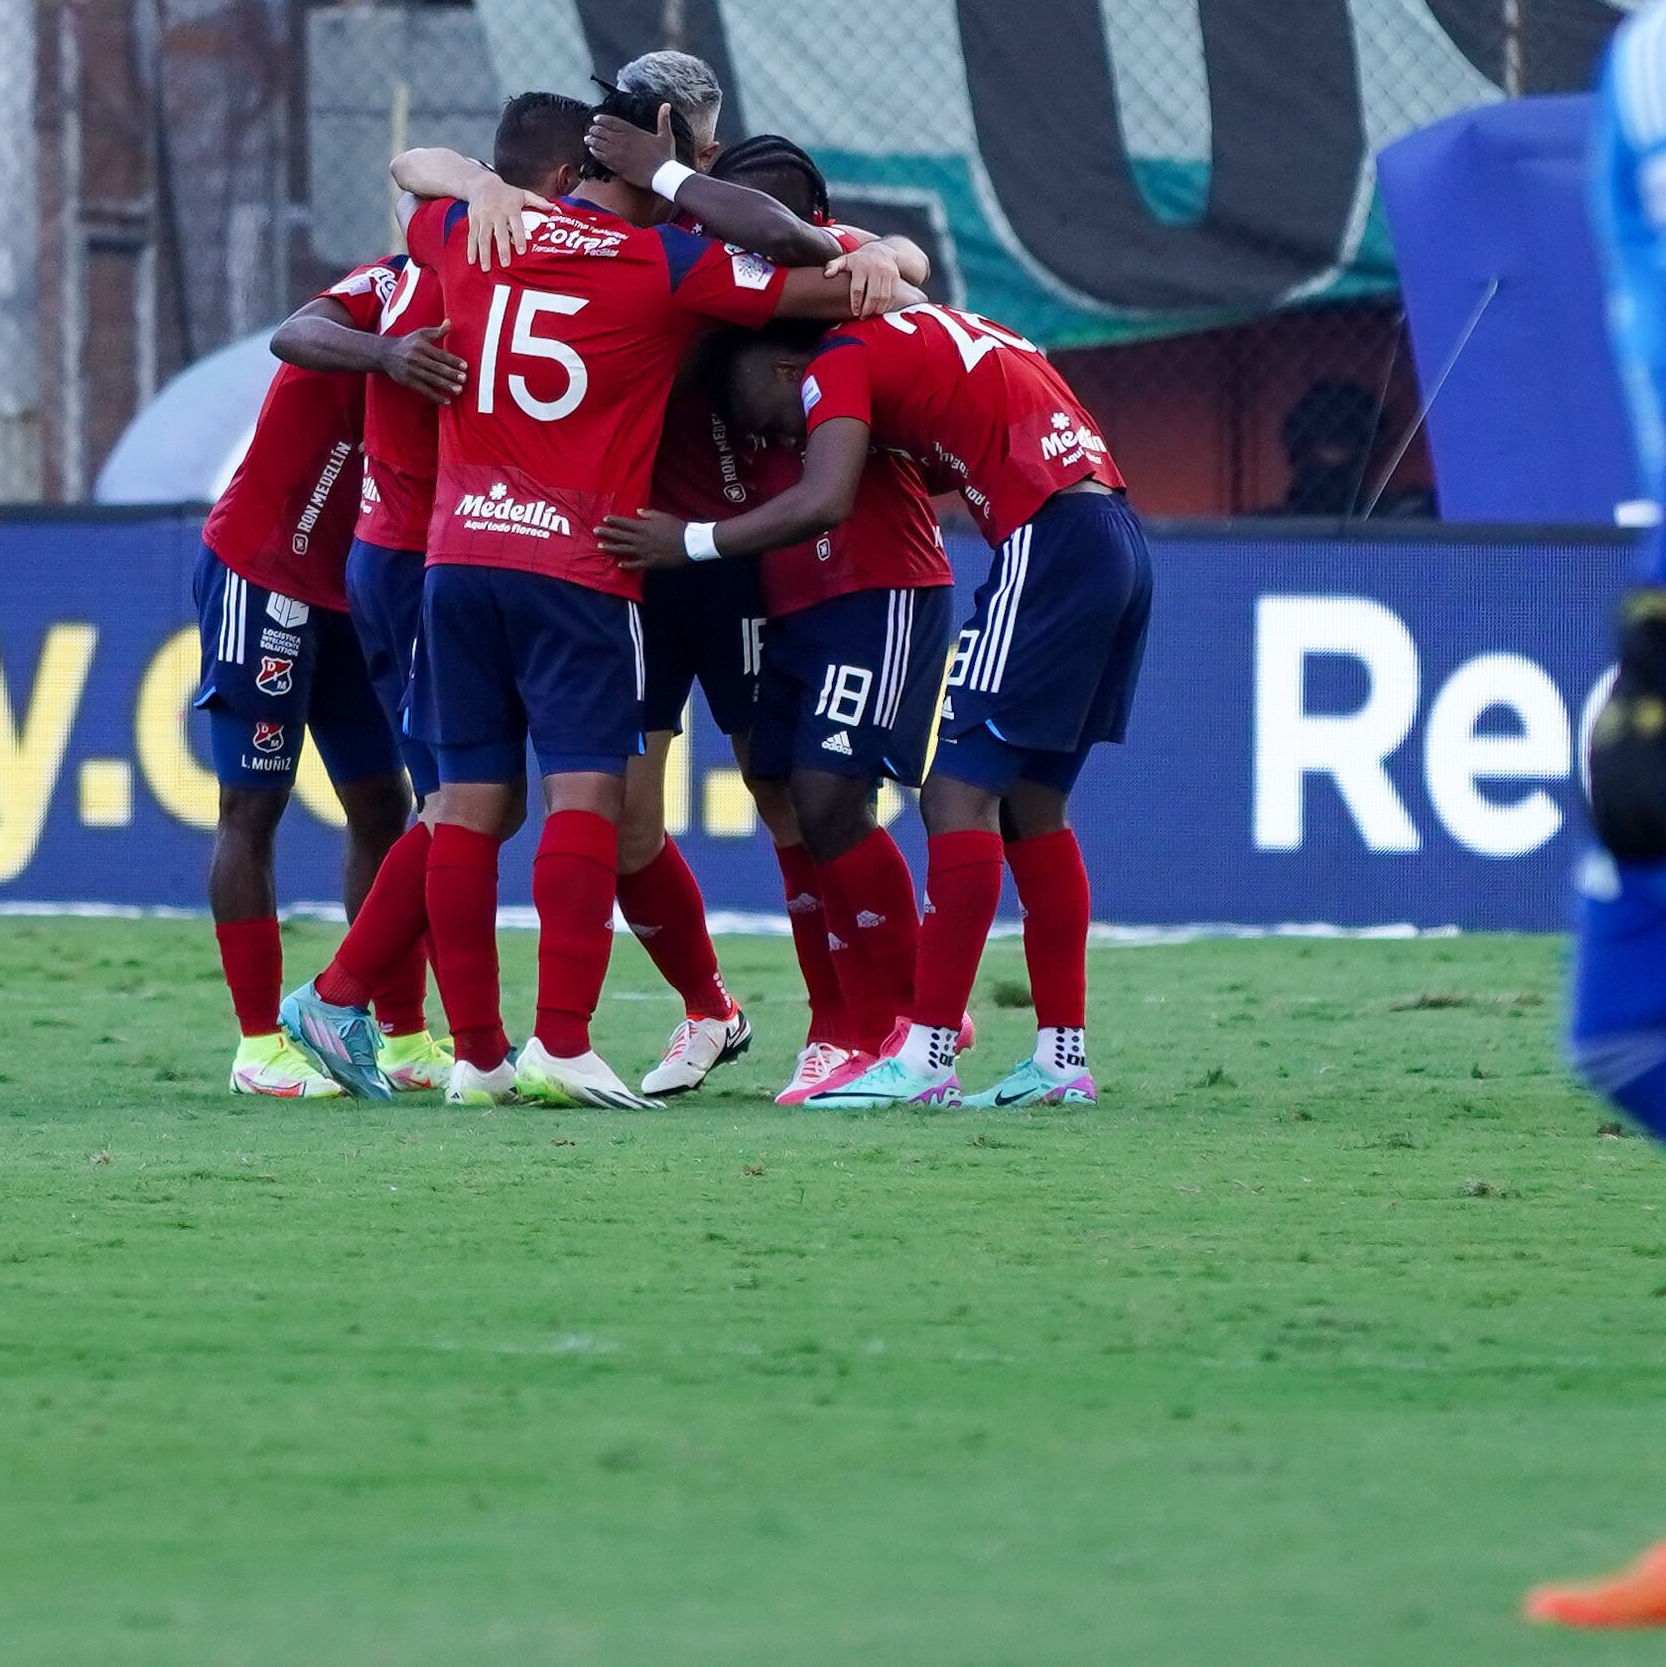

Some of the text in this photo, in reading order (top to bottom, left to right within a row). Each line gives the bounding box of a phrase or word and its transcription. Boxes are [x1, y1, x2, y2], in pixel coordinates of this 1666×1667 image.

[478, 284, 588, 422] 15
[454, 494, 571, 536] Medellín
[815, 664, 873, 726] 18
